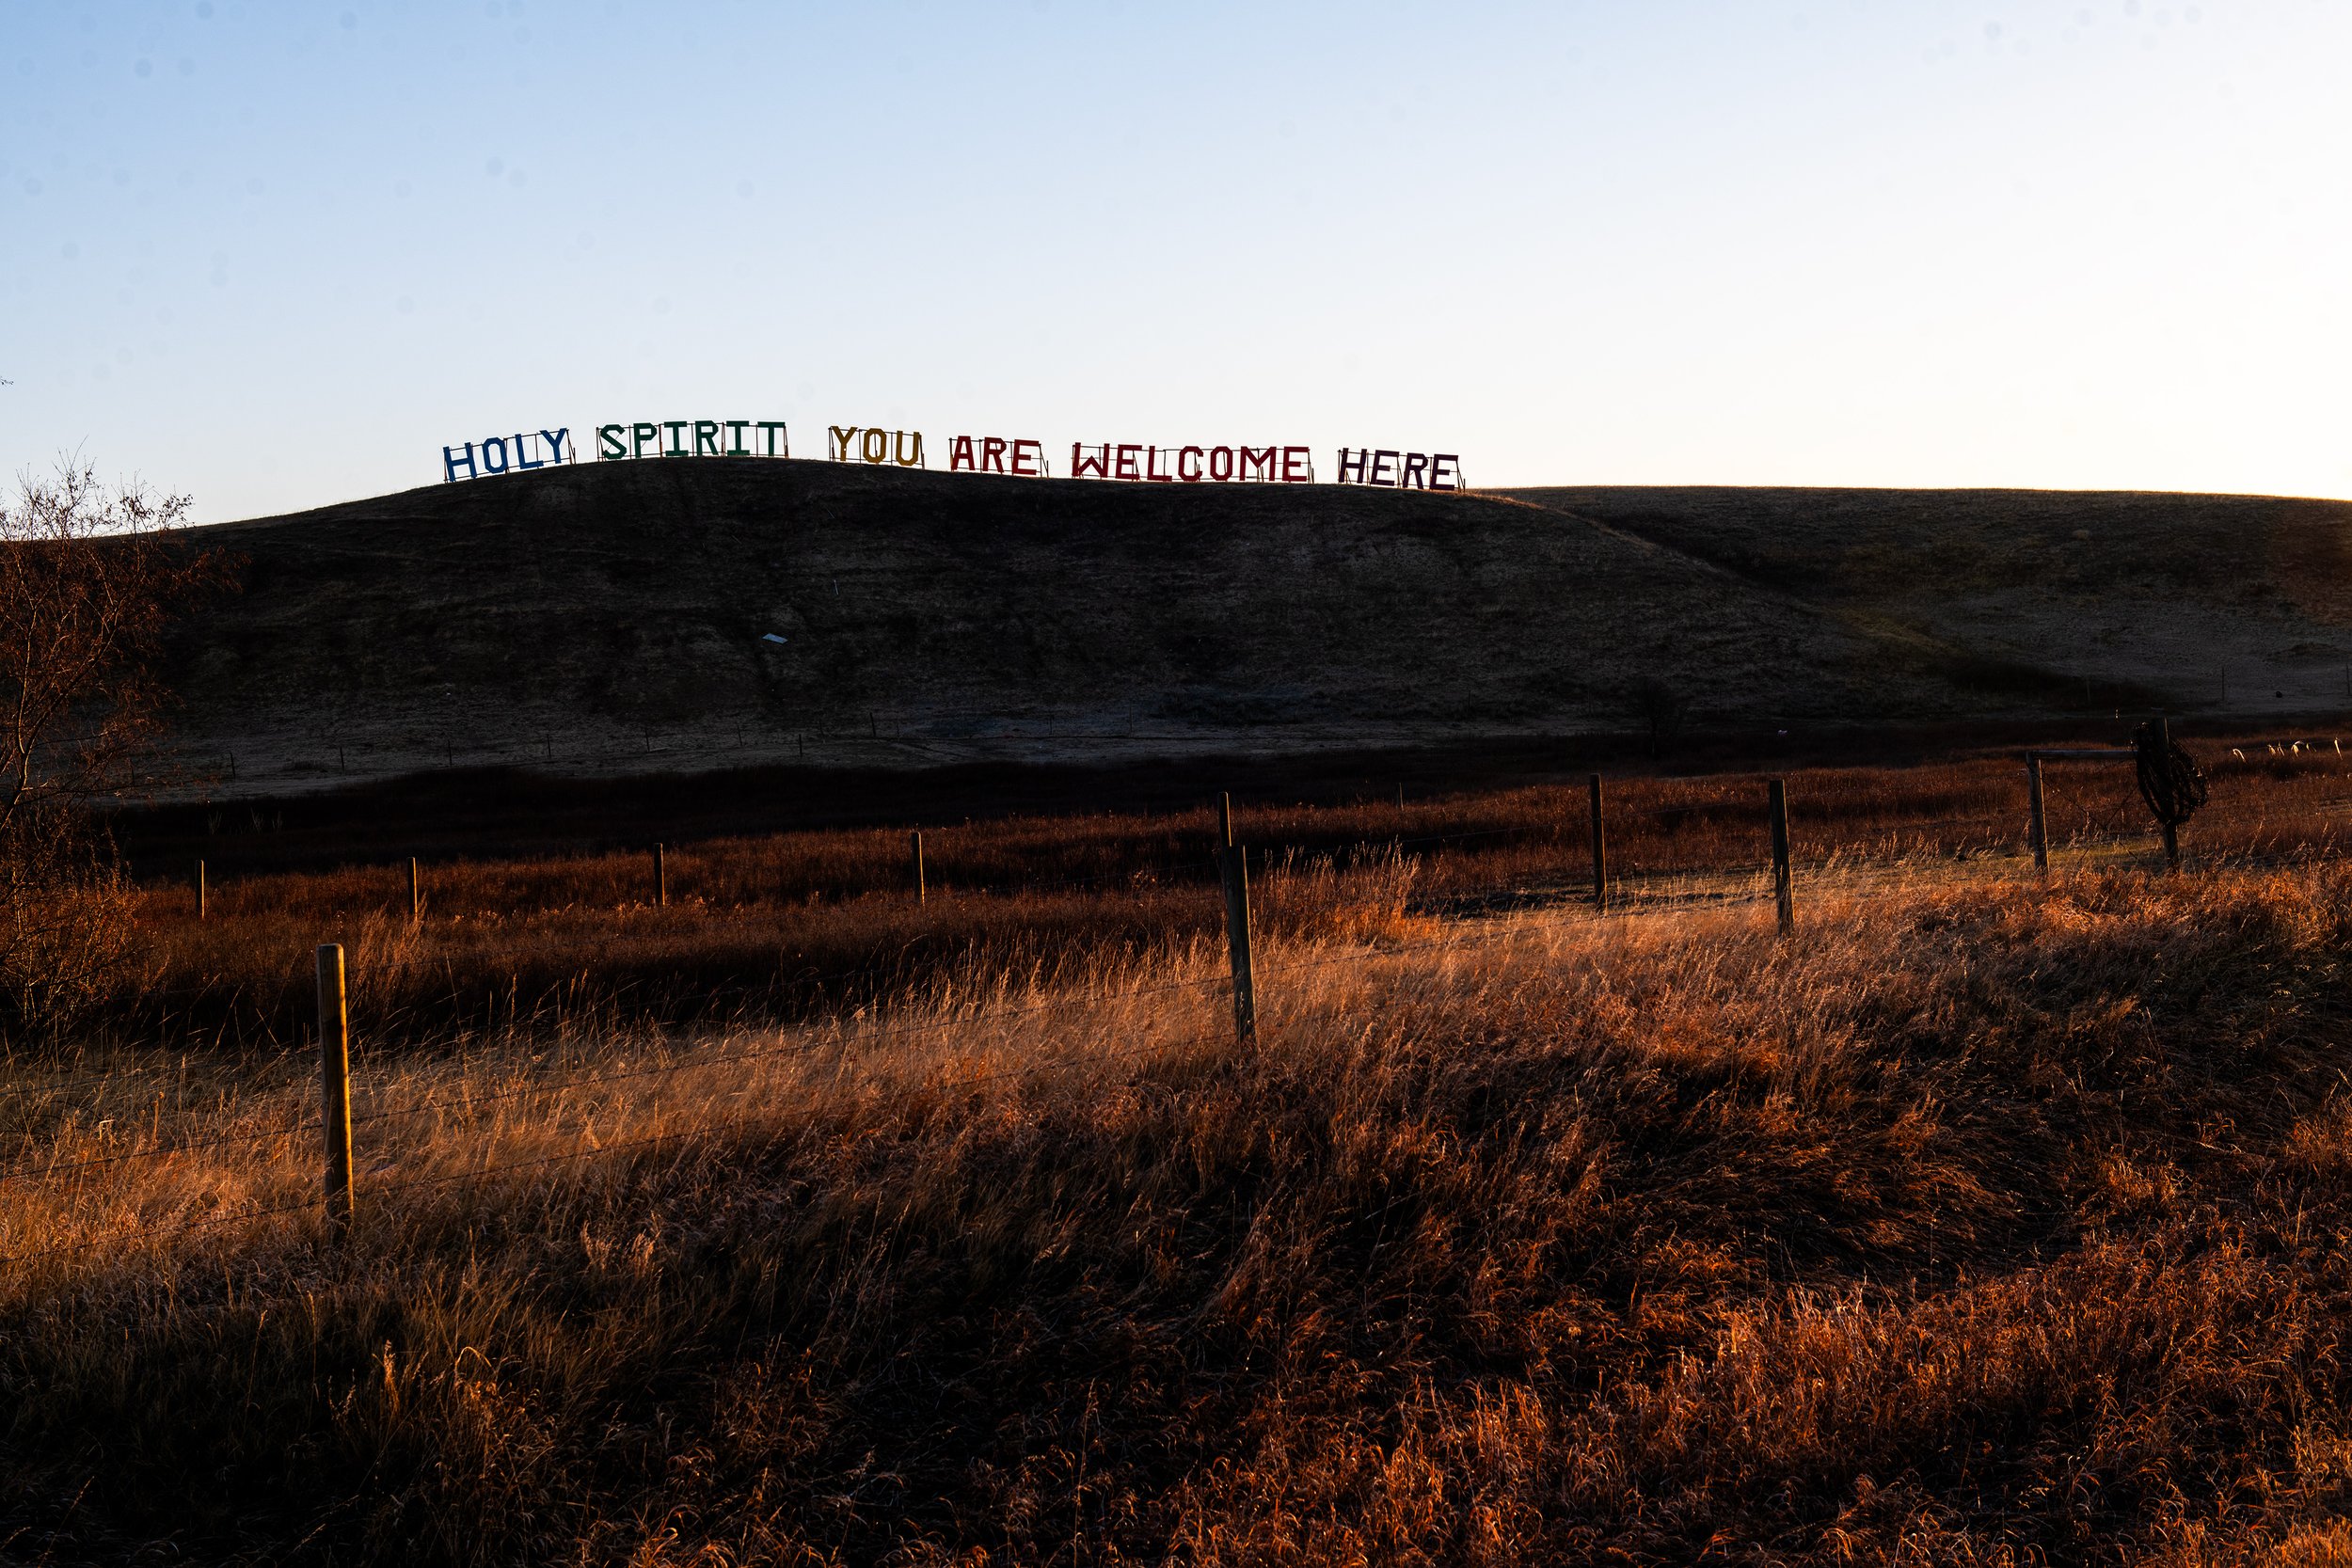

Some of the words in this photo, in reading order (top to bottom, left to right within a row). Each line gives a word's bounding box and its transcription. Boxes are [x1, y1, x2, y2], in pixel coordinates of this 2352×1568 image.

[443, 428, 567, 482] HOLY
[600, 420, 786, 460] SPIRIT
[831, 426, 919, 467] YOU
[951, 436, 1040, 475] ARE
[1073, 442, 1310, 483] WELCOME
[1338, 448, 1458, 491] HERE
